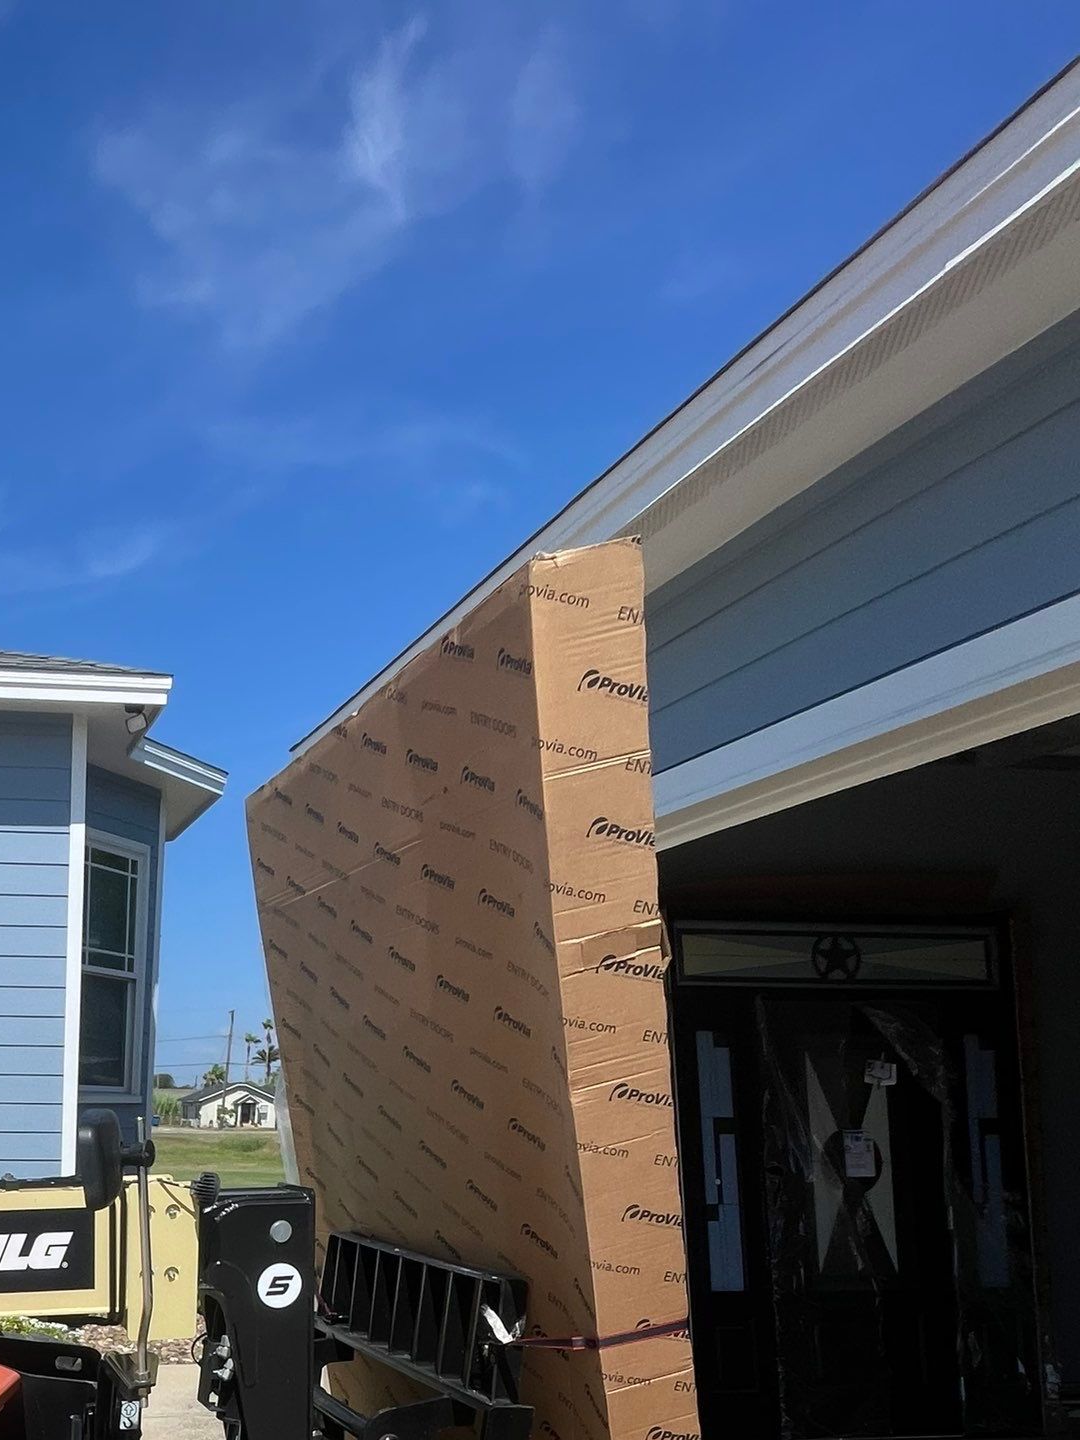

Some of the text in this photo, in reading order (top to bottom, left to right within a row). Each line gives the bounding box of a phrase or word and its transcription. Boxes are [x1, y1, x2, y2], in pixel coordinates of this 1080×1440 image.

[526, 584, 590, 608] ovia.com
[538, 738, 598, 760] ovia.com
[549, 882, 606, 903] ovia.com
[614, 958, 665, 980] ProVia
[562, 1016, 616, 1034] ovia.com
[576, 1141, 629, 1158] ovia.com
[639, 1210, 682, 1227] ProVia
[602, 1372, 652, 1386] ovia.com
